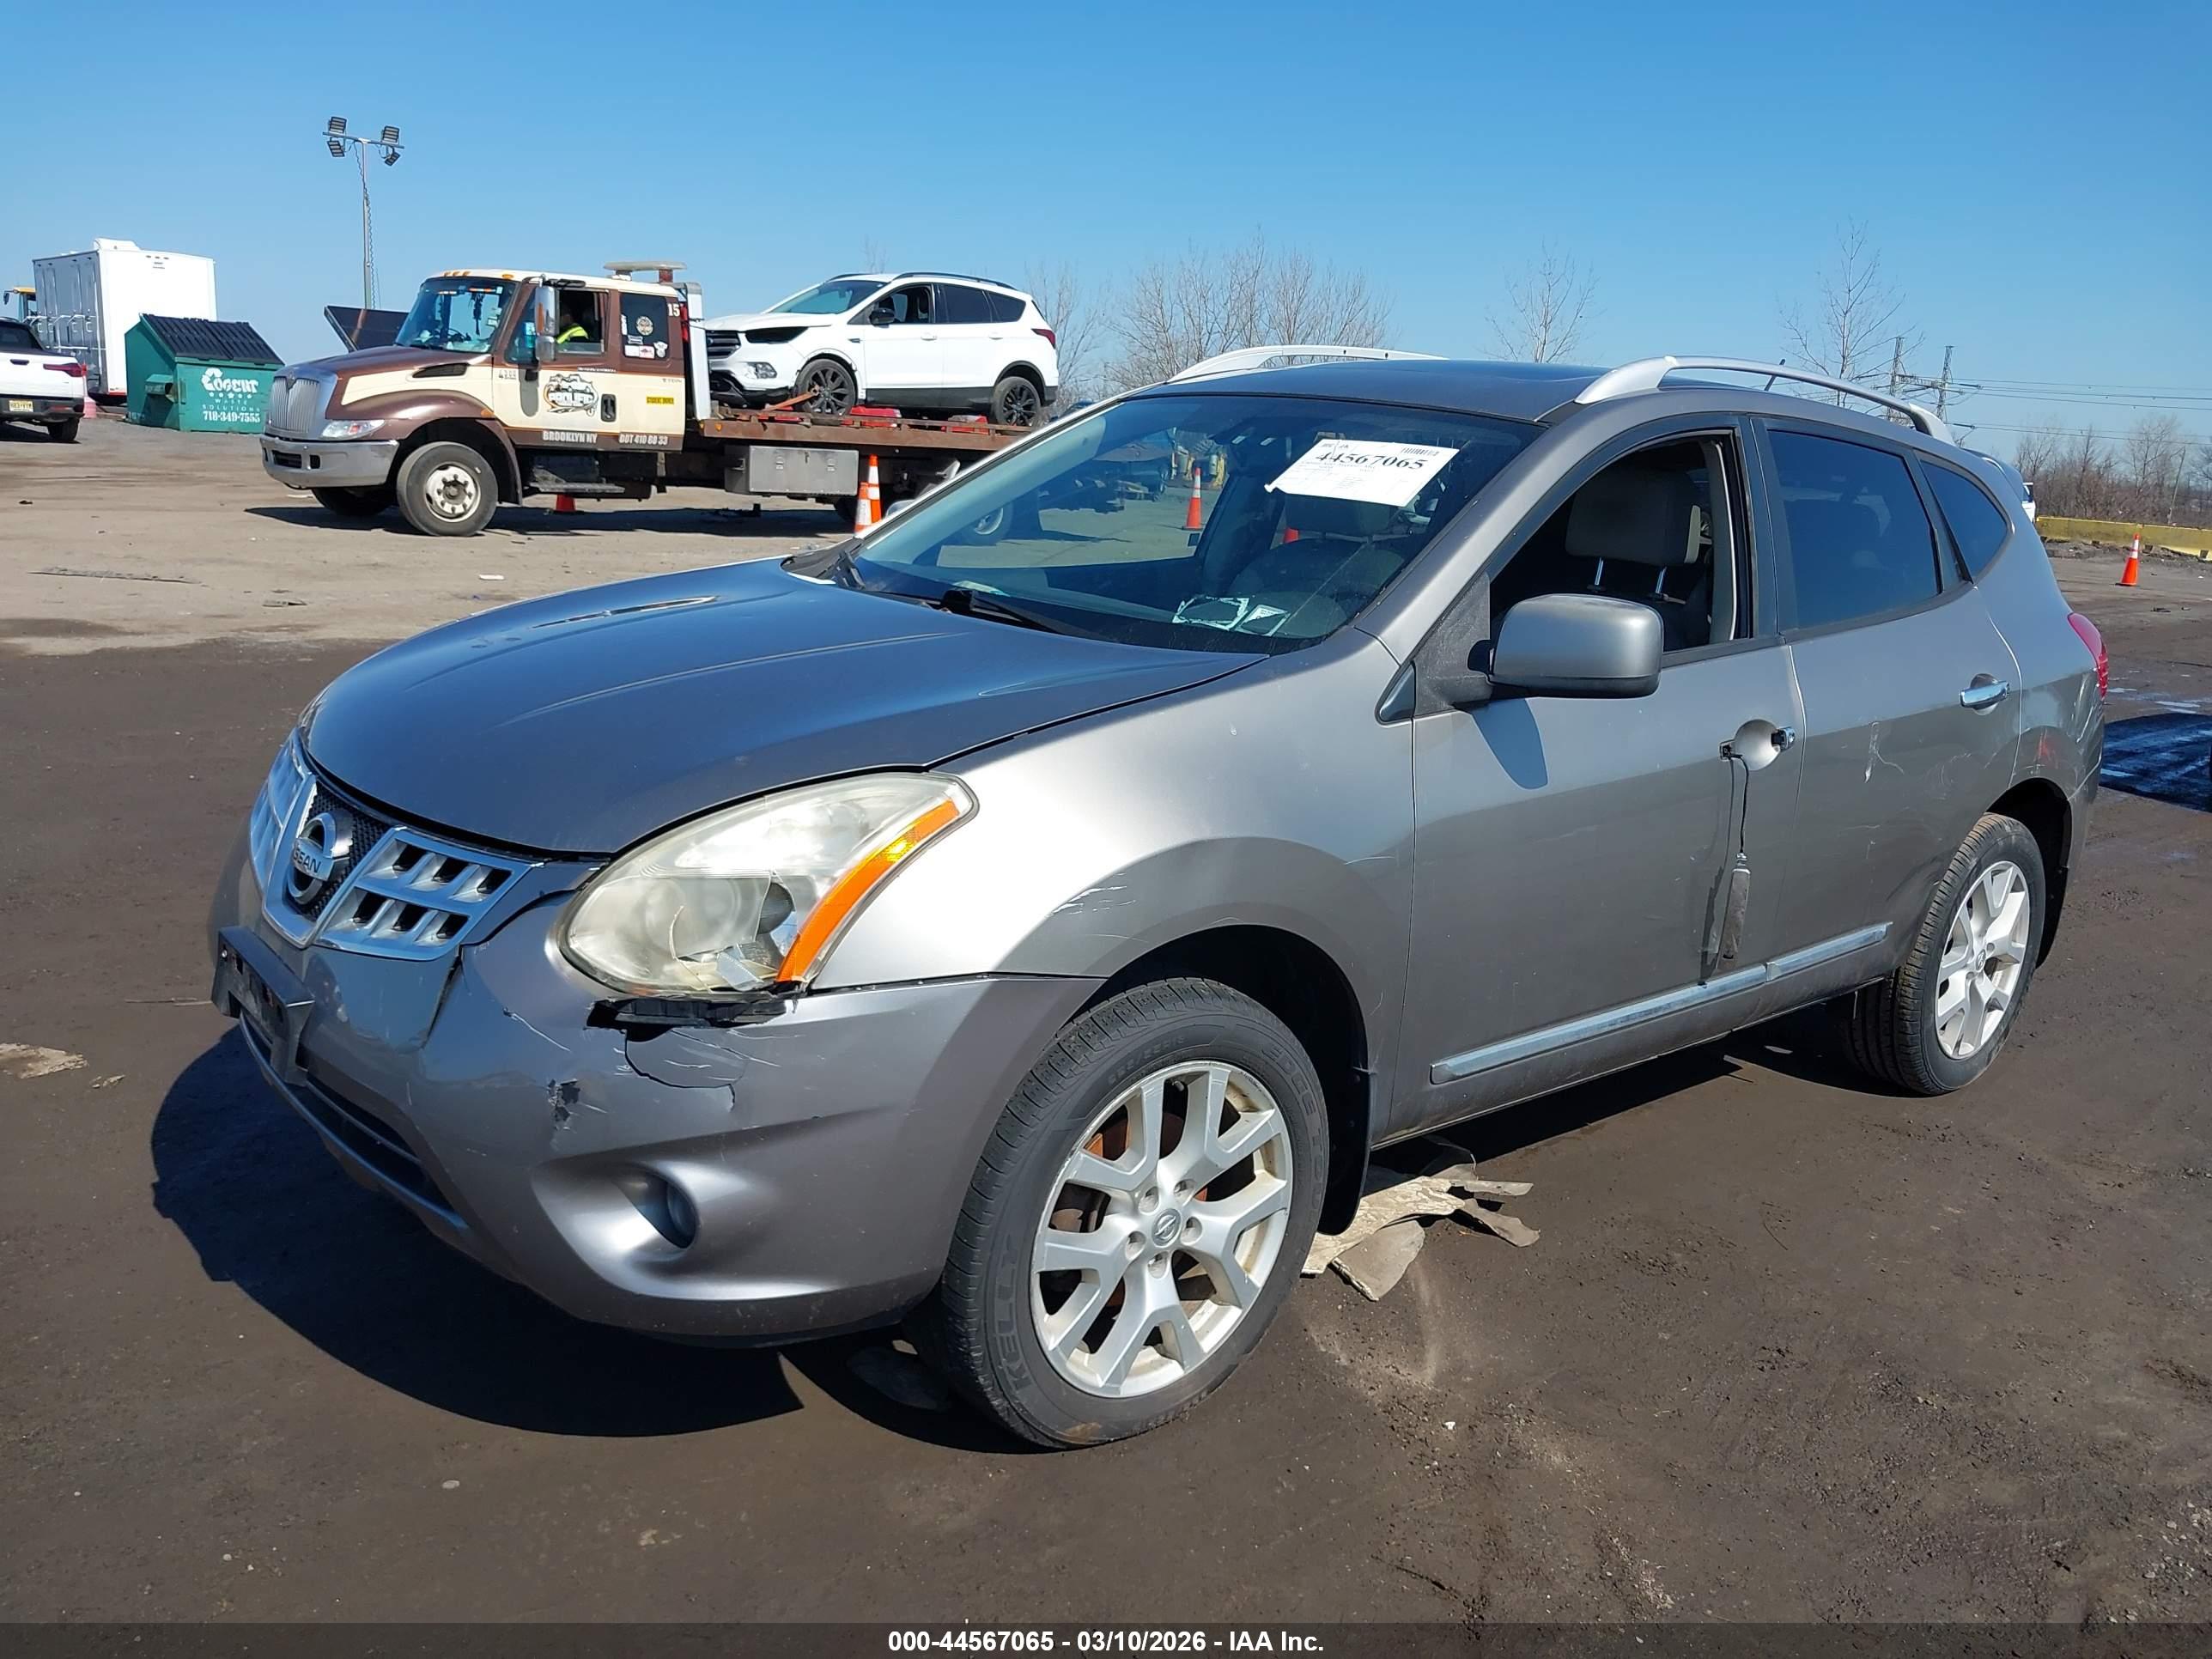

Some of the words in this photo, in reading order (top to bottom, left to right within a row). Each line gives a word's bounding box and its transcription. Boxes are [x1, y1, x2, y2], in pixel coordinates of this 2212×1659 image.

[667, 303, 680, 317] 15
[203, 410, 260, 422] 718-349-7555
[543, 430, 585, 443] BROOKLYN
[586, 432, 598, 444] NY
[1316, 452, 1428, 469] 44567065
